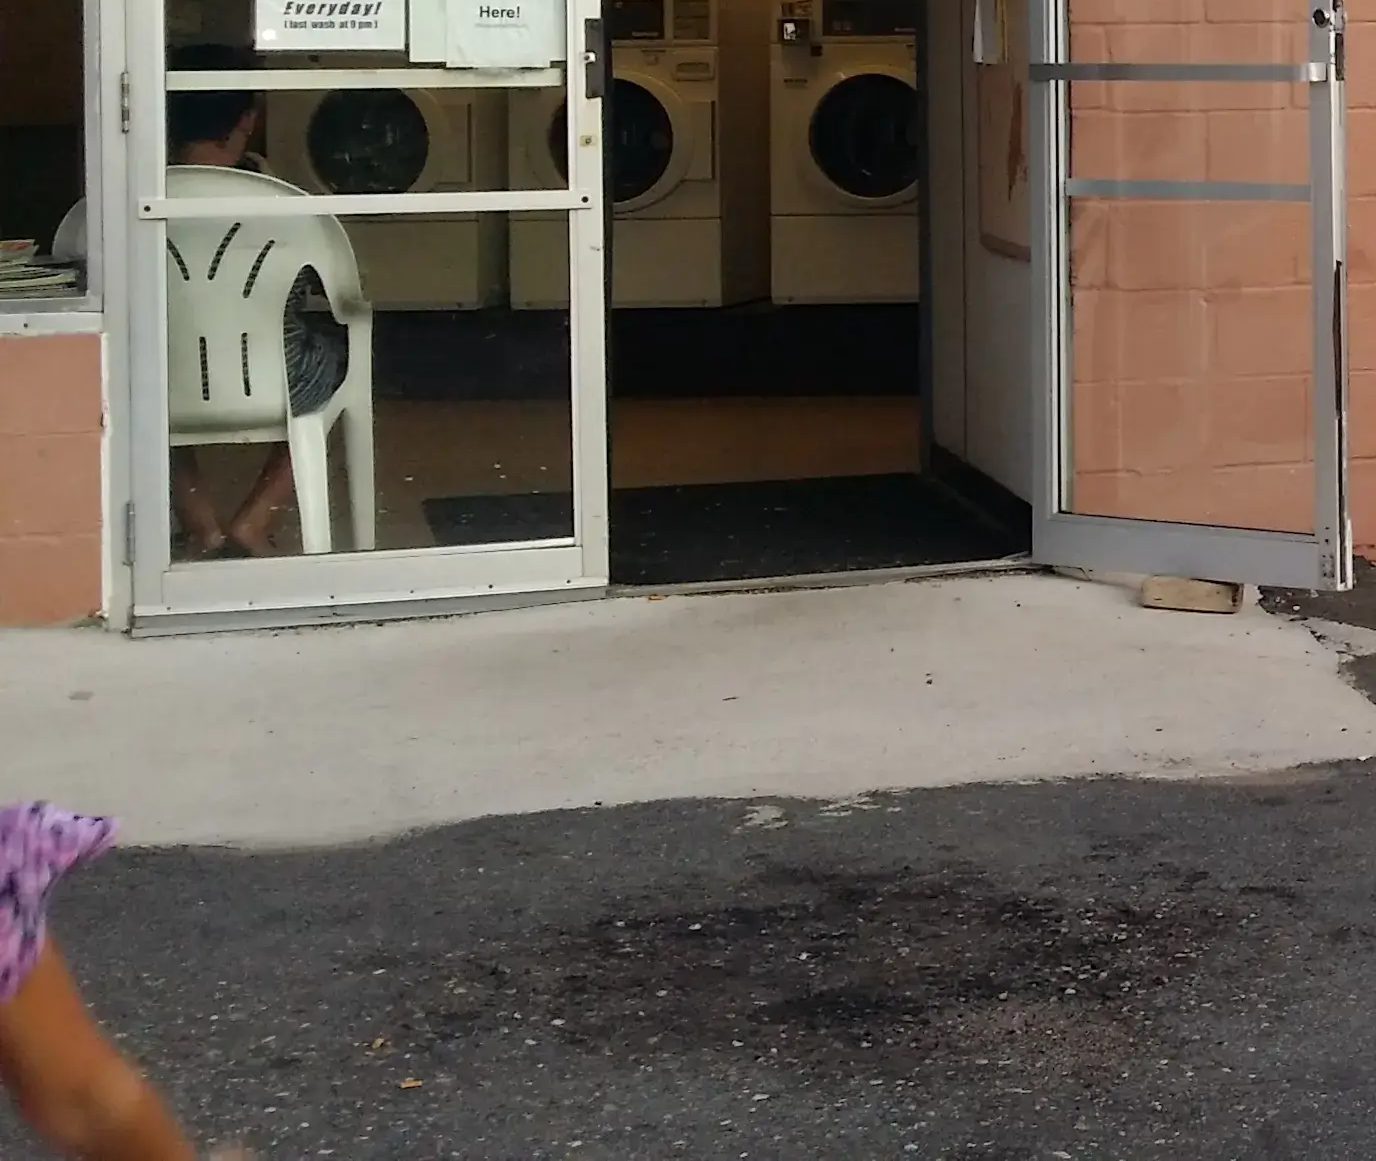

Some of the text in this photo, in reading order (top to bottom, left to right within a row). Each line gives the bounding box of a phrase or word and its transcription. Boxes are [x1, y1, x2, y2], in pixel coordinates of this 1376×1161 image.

[284, 1, 382, 17] Everyday!
[479, 5, 521, 19] Here!
[311, 20, 336, 29] wash
[339, 20, 349, 29] at
